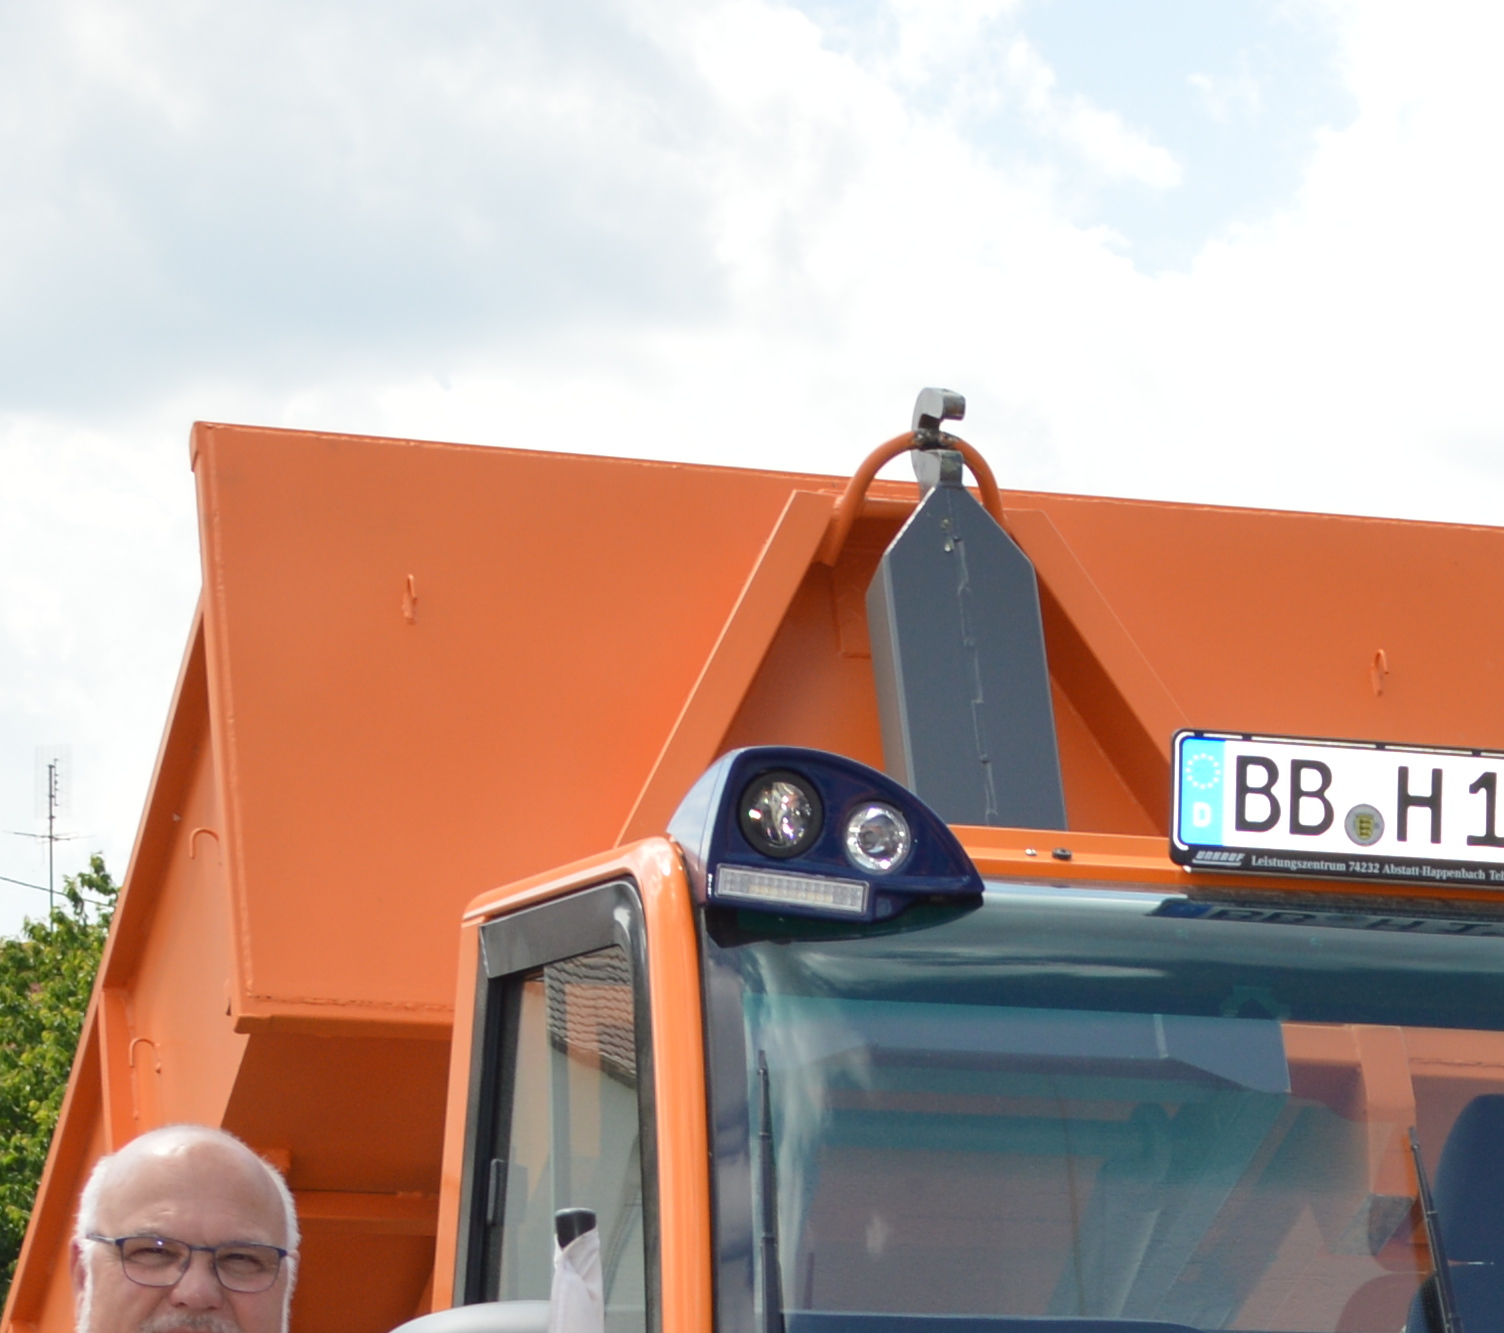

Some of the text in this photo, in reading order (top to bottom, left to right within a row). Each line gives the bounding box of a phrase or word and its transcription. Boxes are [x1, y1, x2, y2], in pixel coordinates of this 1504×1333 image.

[1234, 755, 1334, 835] BB
[1396, 766, 1443, 844] H
[1191, 801, 1212, 827] D
[1251, 855, 1346, 871] Leistungszentrum
[1349, 861, 1380, 873] 74232
[1382, 862, 1486, 880] Abstatt-Happenbach
